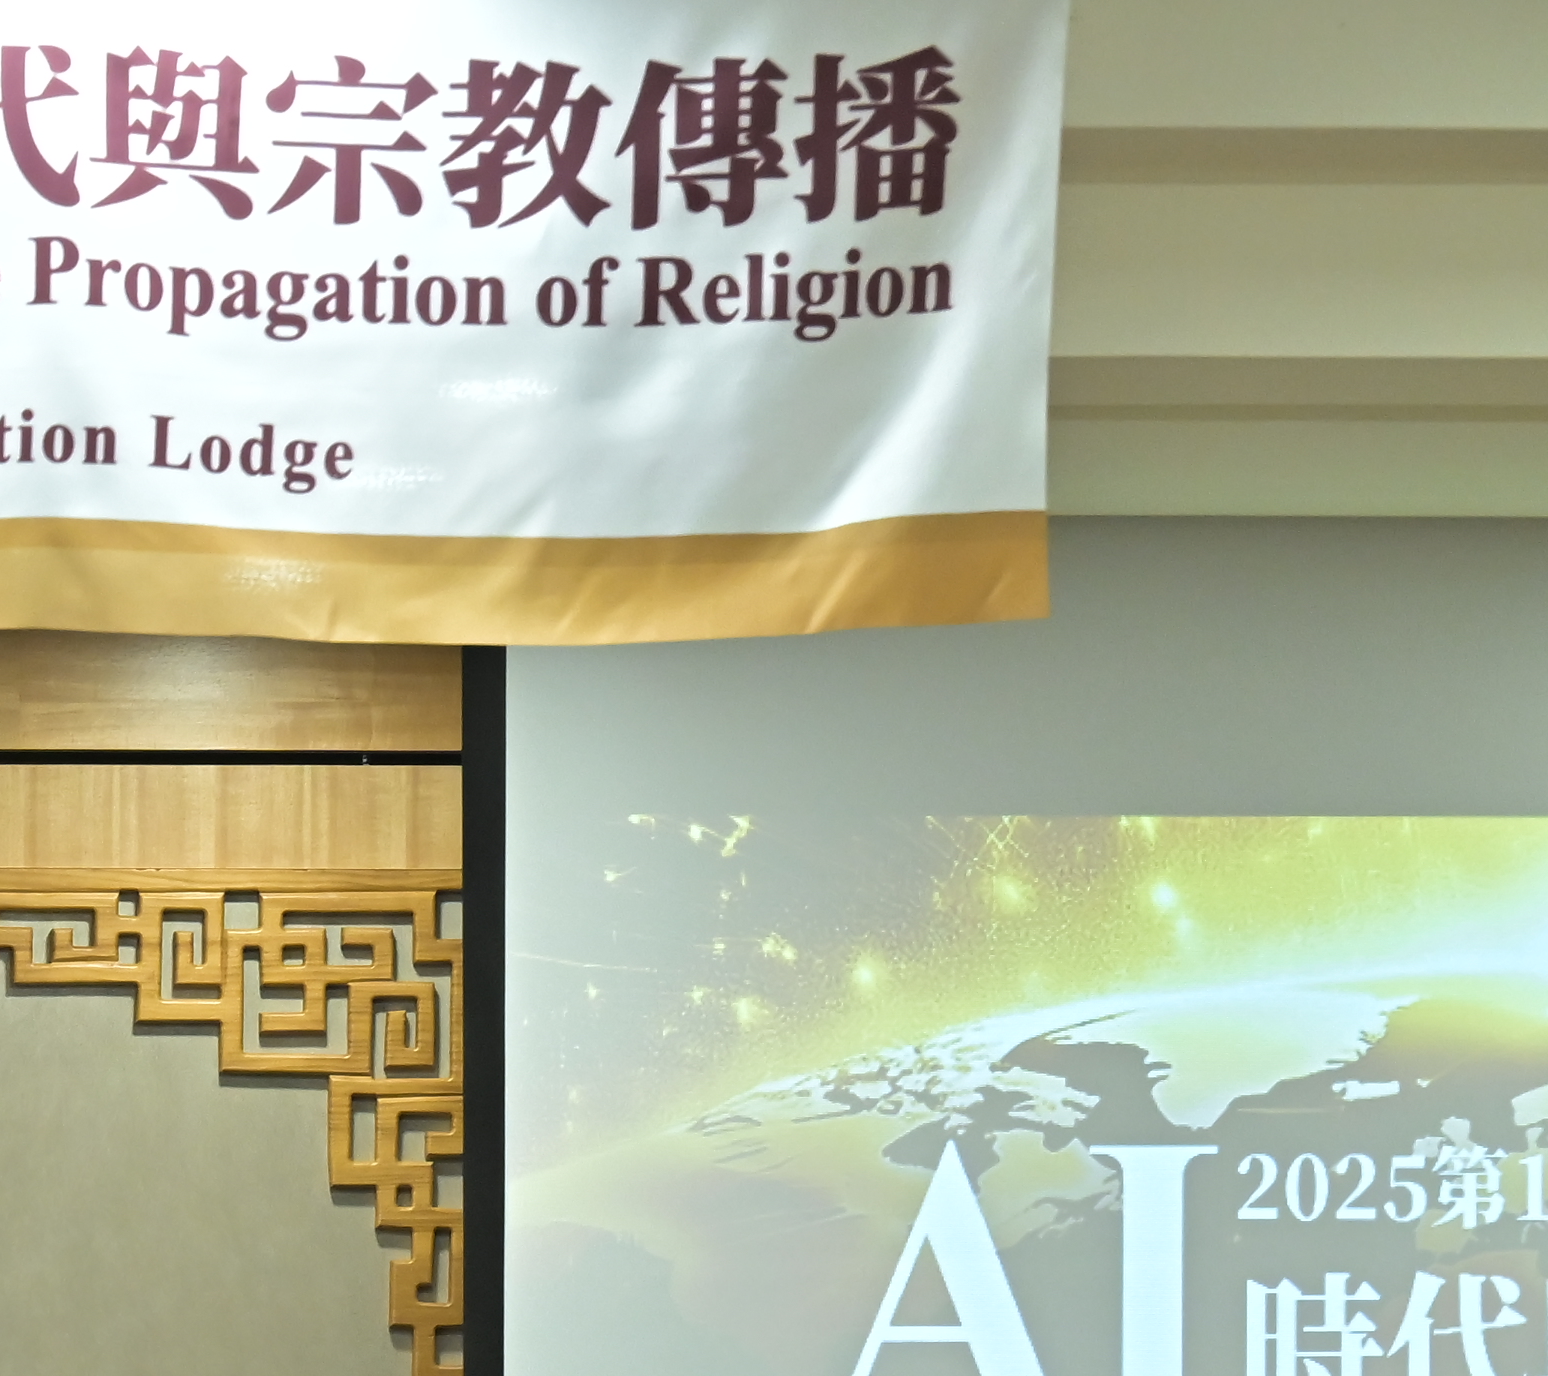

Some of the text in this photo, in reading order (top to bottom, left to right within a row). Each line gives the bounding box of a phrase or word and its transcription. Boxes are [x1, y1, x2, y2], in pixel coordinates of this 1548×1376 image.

[28, 236, 507, 341] Propagation
[536, 257, 621, 328] of
[633, 248, 954, 342] Religion
[151, 416, 354, 495] Lodge
